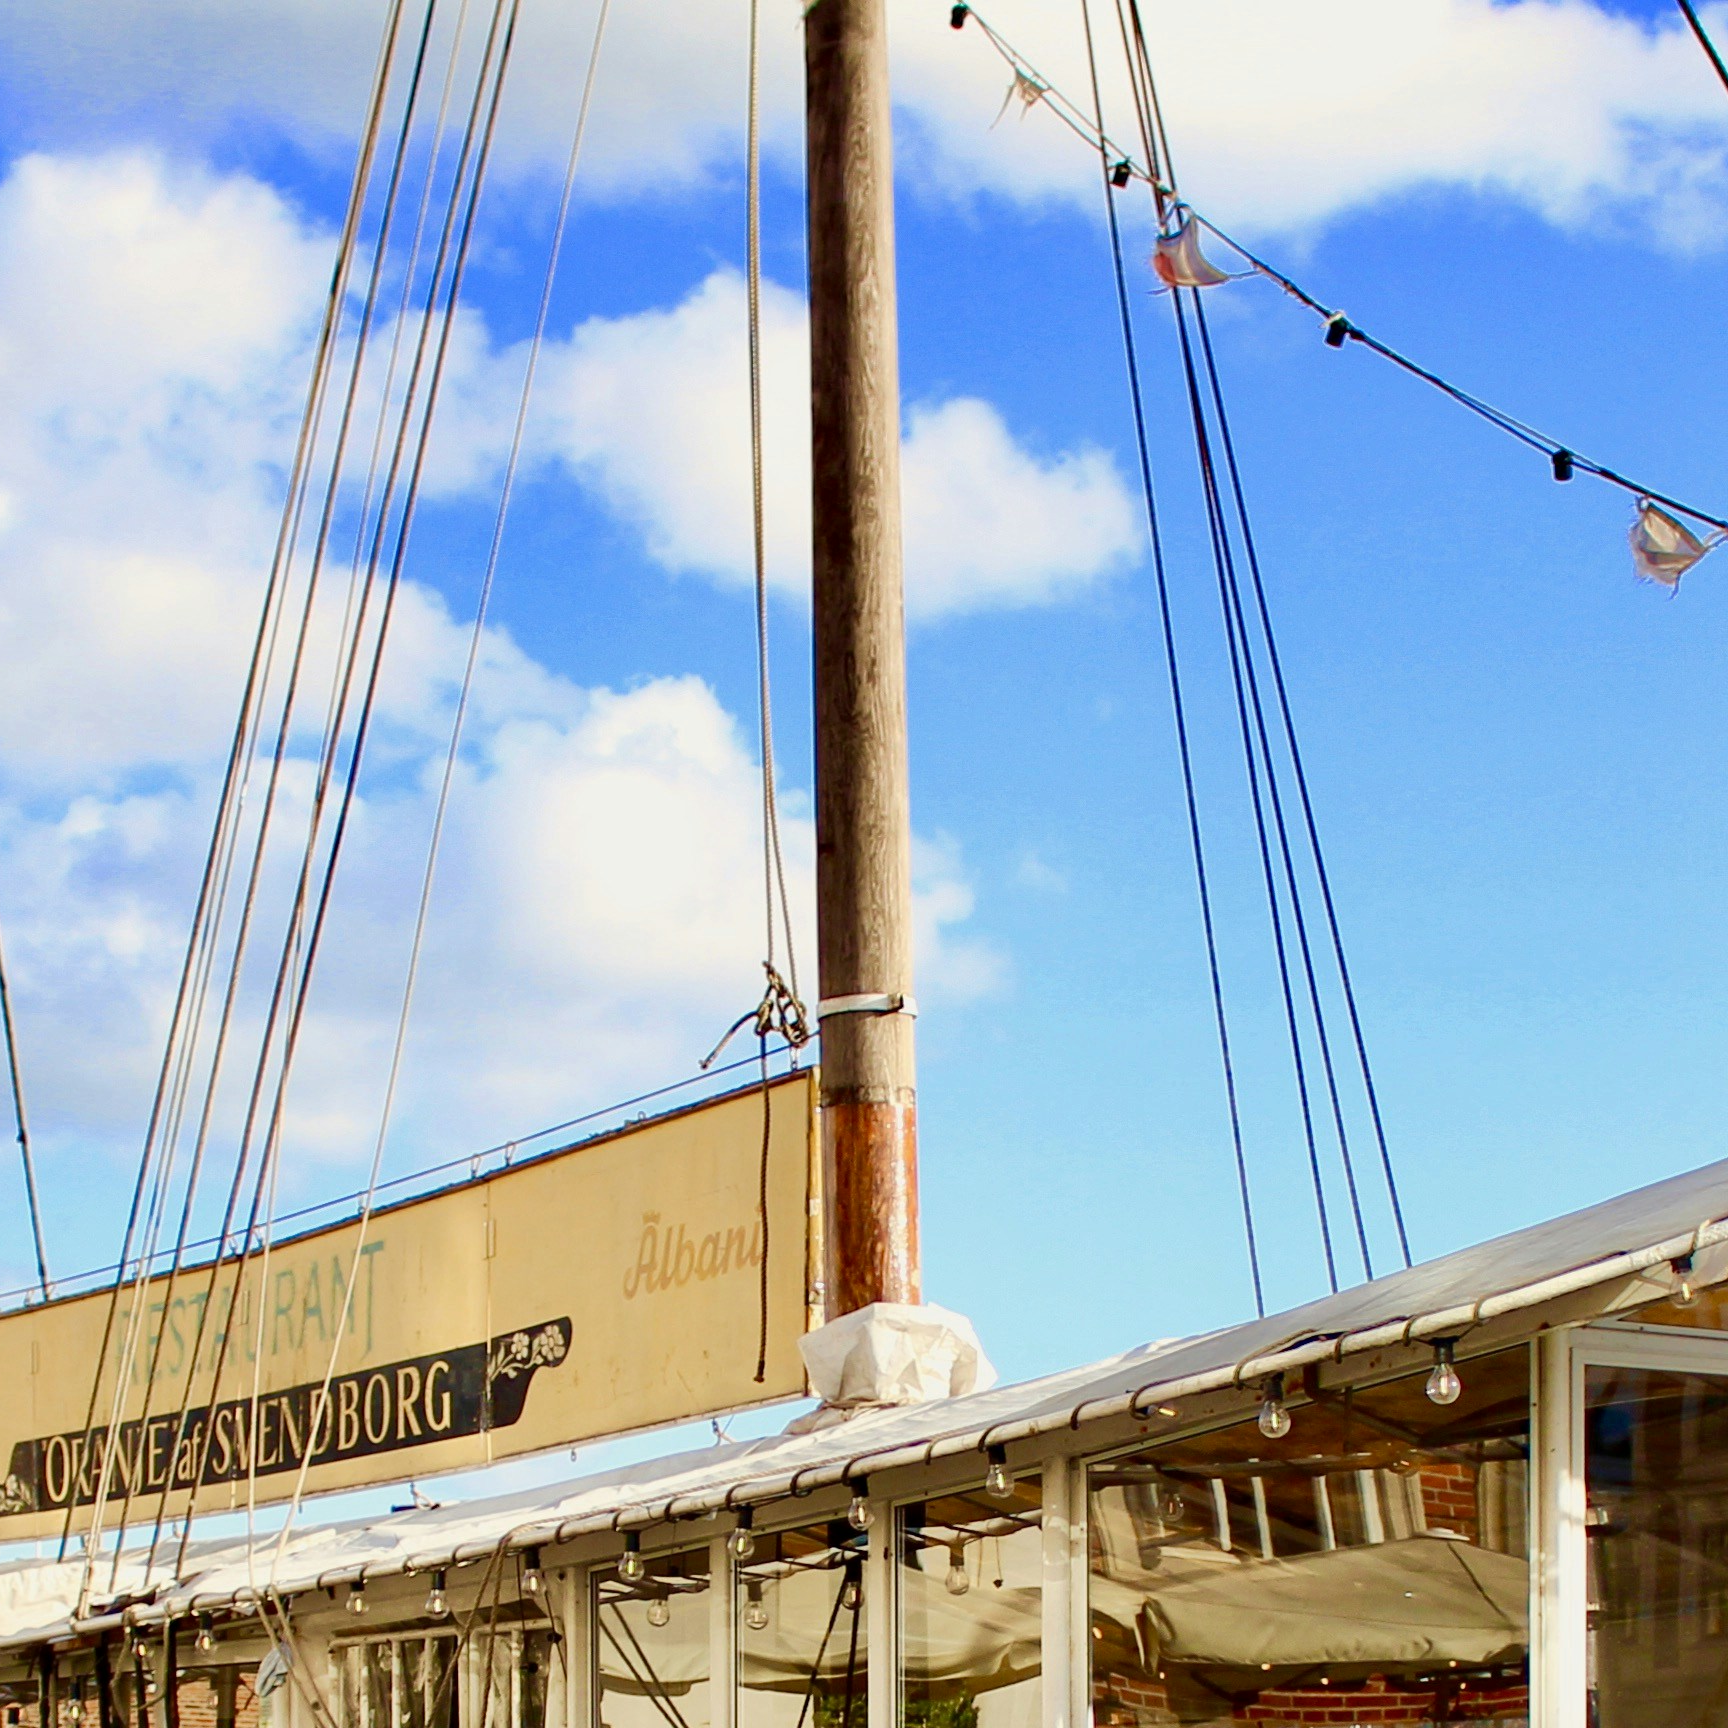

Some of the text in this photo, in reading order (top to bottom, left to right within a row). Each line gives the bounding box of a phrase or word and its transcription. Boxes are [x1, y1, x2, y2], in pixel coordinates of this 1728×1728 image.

[623, 1203, 764, 1300] Albani
[115, 1240, 385, 1386] RESTAURANT
[177, 1421, 203, 1482] af
[212, 1360, 451, 1475] SVENDBORG
